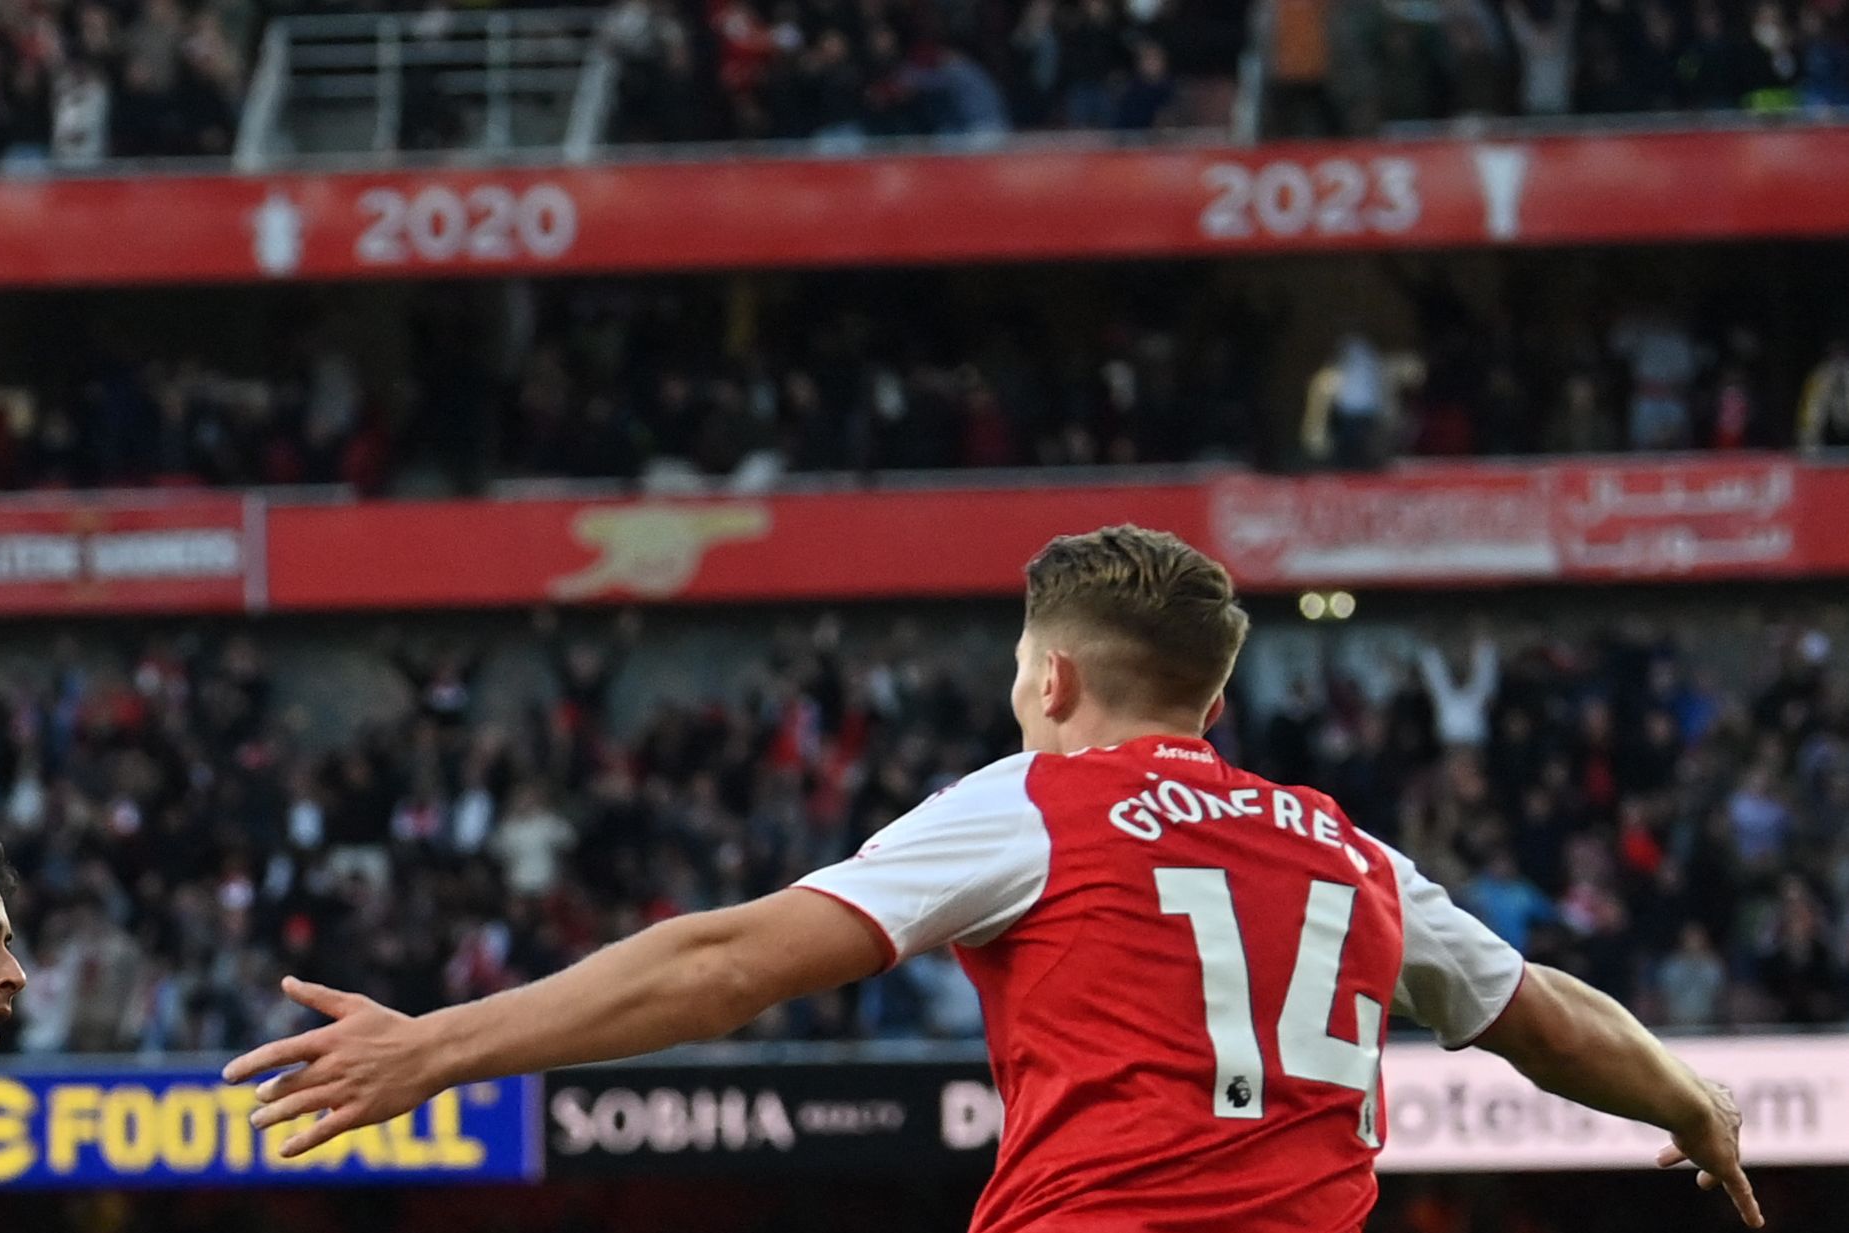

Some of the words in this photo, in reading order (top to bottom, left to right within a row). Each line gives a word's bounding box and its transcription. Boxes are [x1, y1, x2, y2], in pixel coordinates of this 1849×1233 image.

[357, 186, 578, 263] 2020
[1201, 157, 1422, 239] 2023
[1153, 743, 1215, 764] Arsenal
[1153, 866, 1383, 1148] 14
